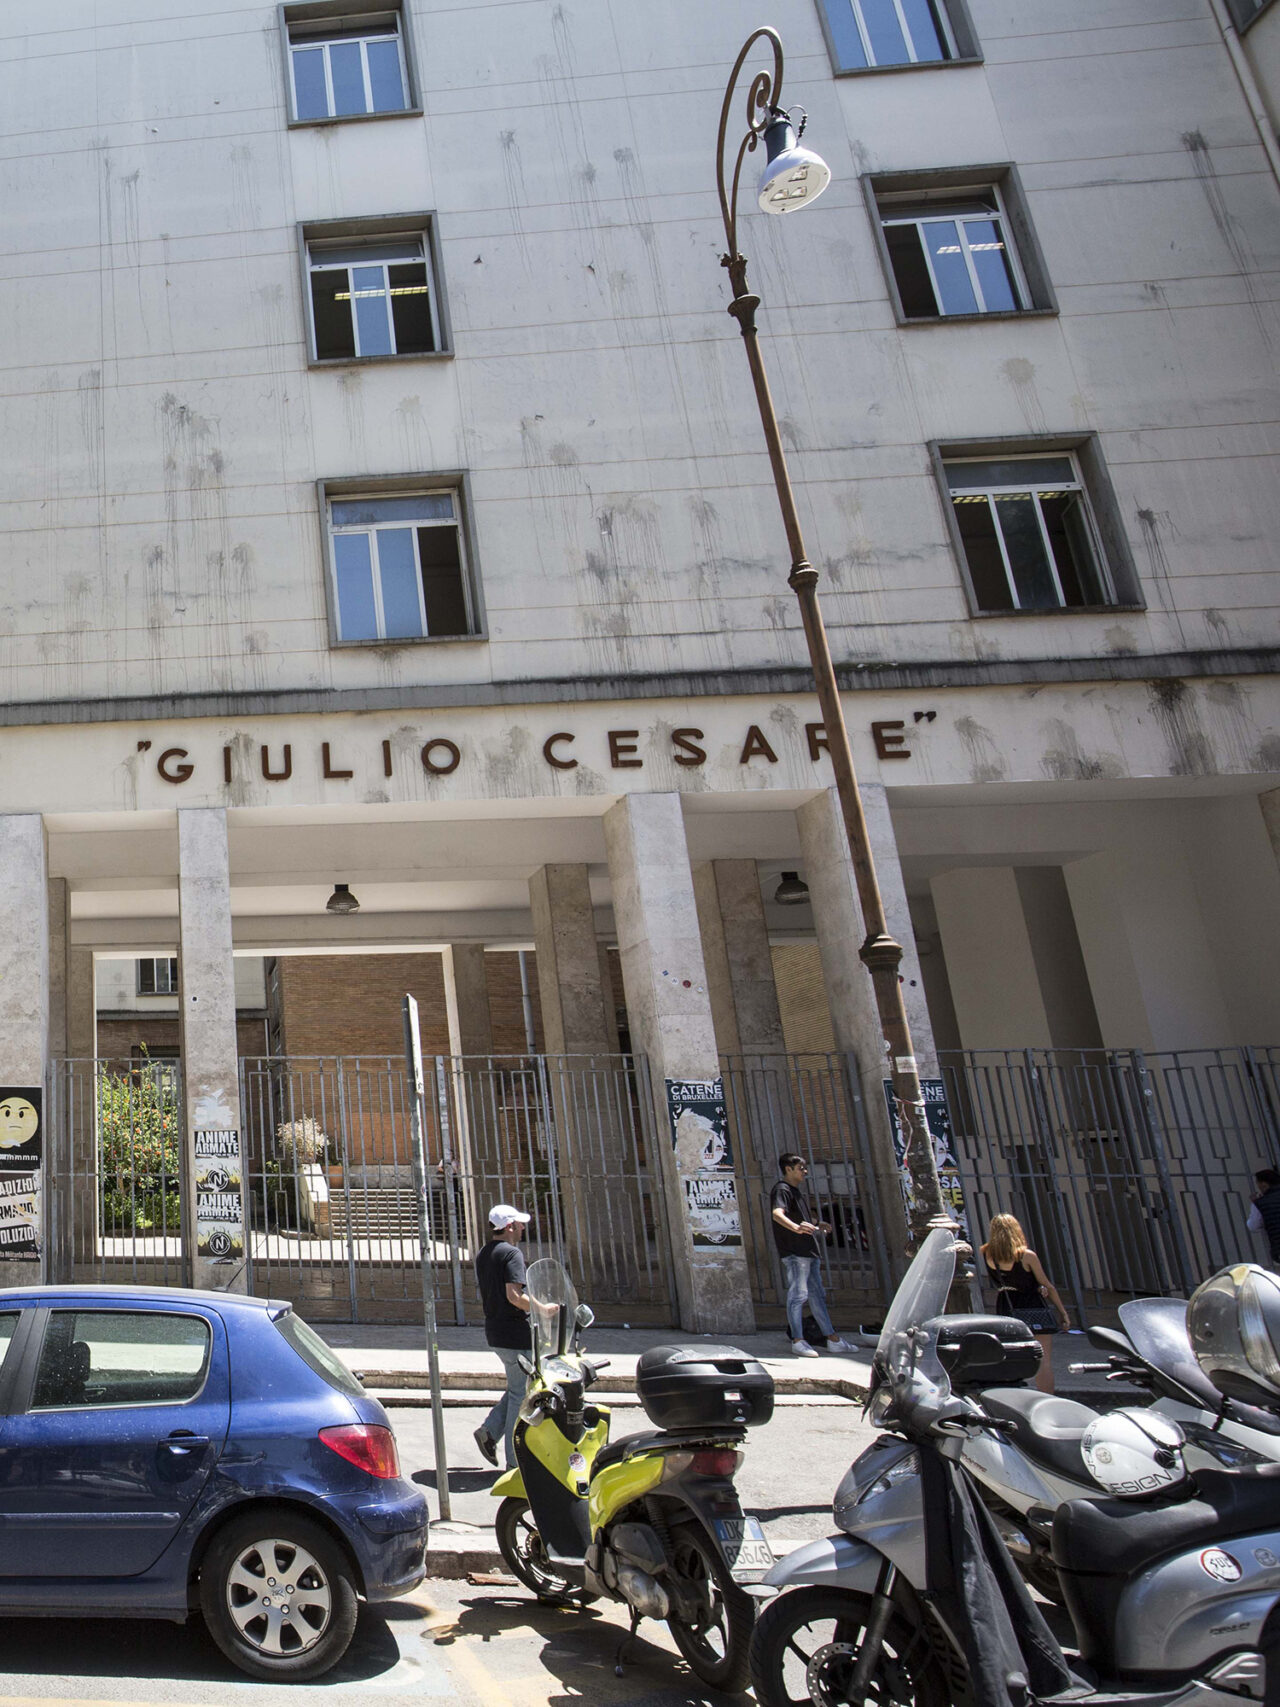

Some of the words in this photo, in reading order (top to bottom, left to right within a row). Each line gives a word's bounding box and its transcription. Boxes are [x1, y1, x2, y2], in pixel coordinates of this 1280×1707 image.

[670, 1085, 722, 1095] CATENE
[920, 1086, 944, 1096] ENE
[682, 1092, 723, 1100] BRUXELLES
[197, 1131, 236, 1143] ANIME
[195, 1142, 239, 1153] ARMATE
[200, 1194, 240, 1206] ANIME
[724, 1520, 745, 1540] DK
